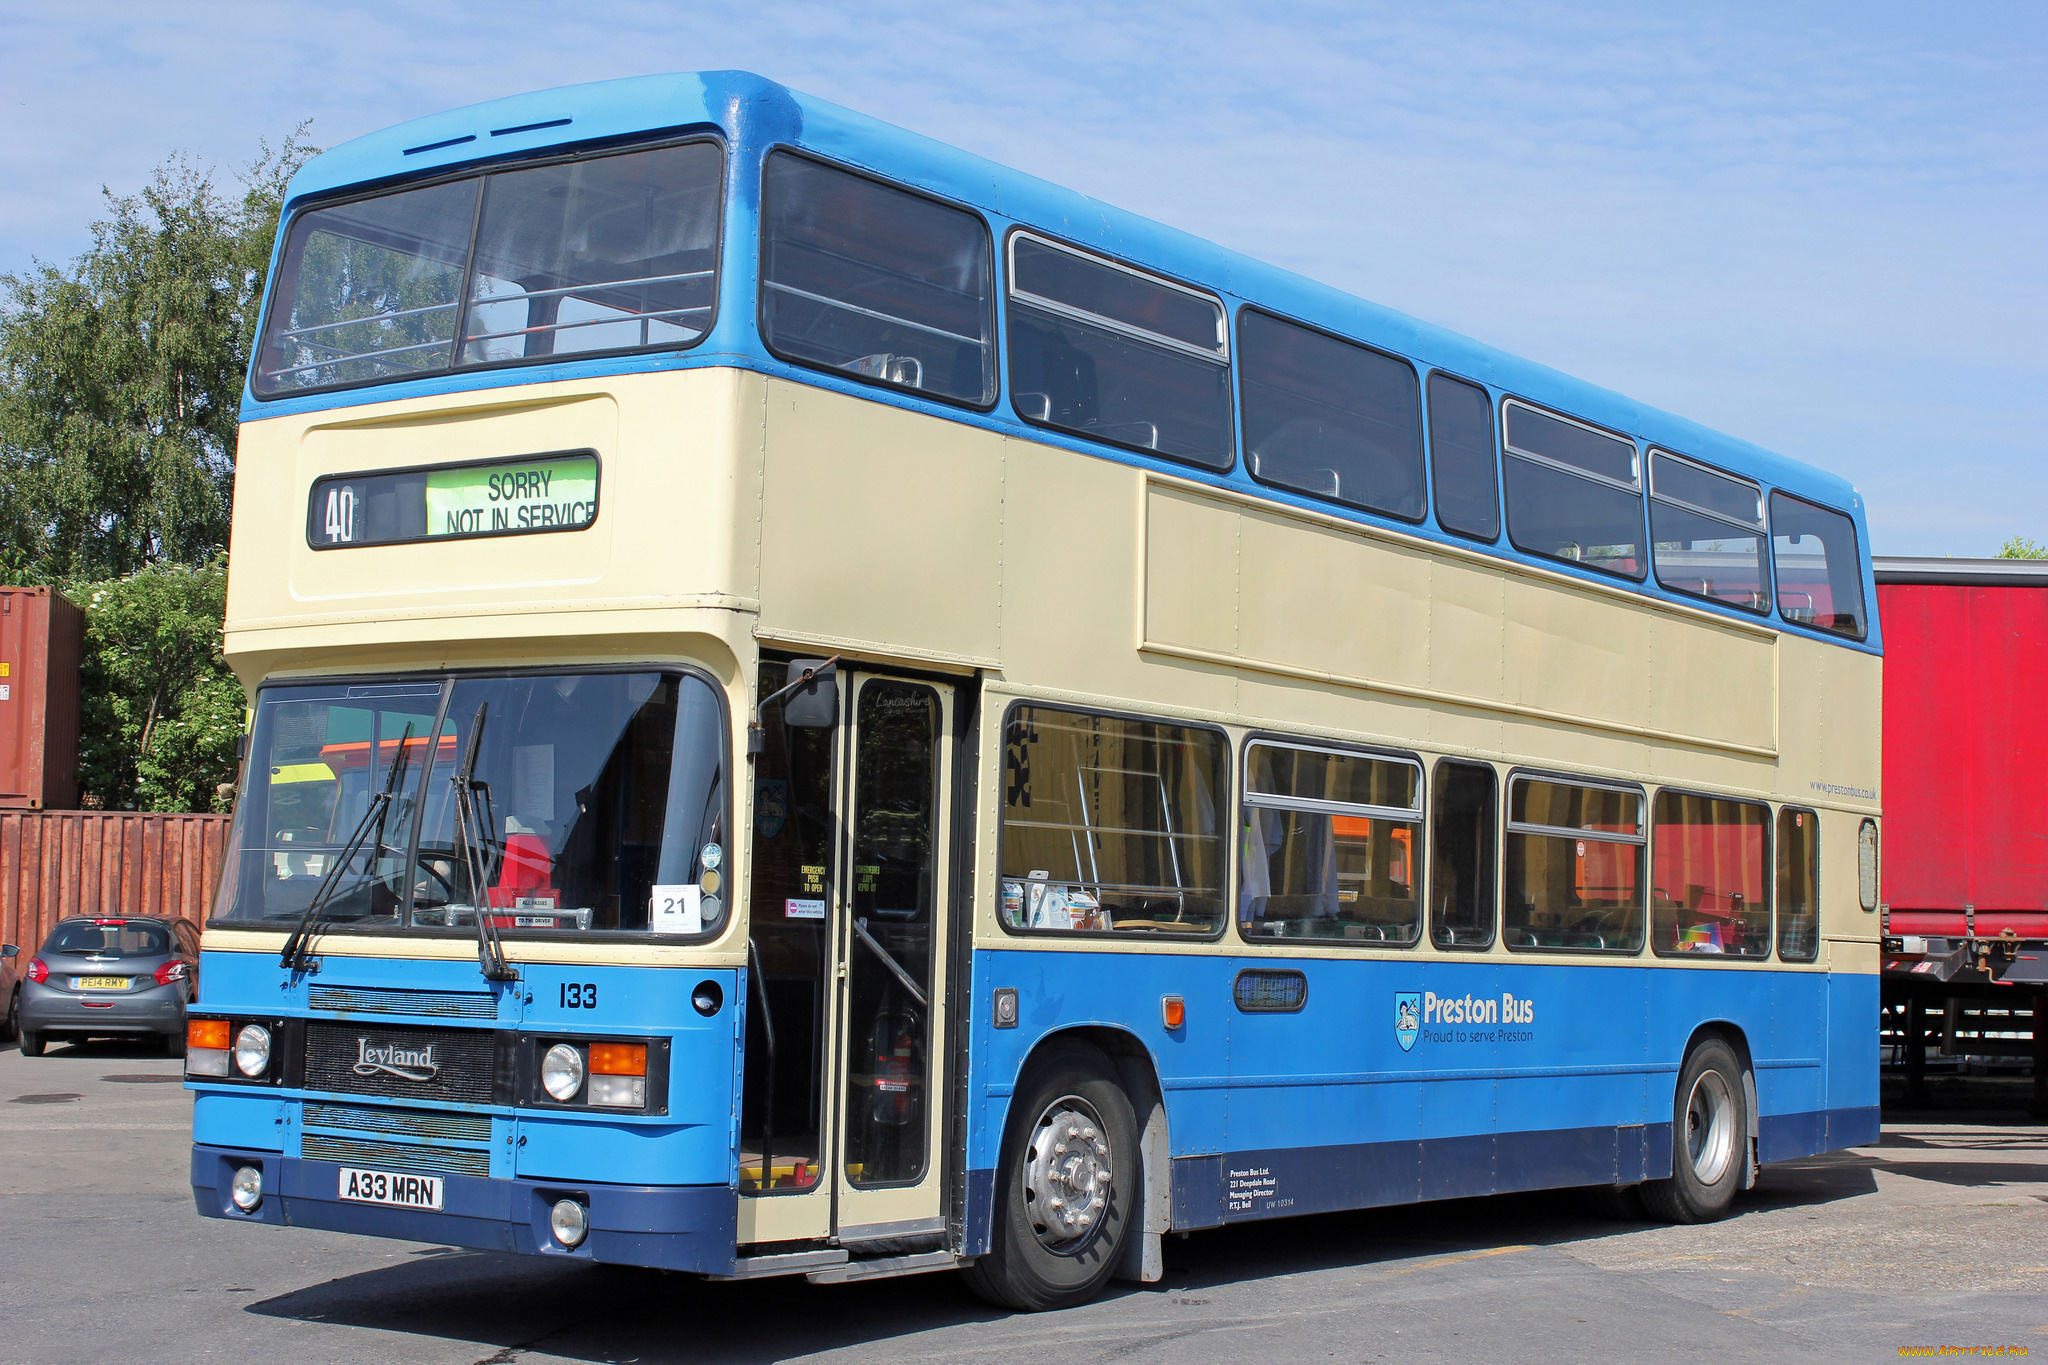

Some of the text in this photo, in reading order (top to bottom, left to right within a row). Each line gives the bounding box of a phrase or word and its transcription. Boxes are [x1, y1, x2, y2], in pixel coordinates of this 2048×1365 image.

[488, 470, 552, 502] SORRY
[325, 485, 354, 543] 40
[447, 508, 484, 534] NOT
[492, 507, 509, 532] IN
[876, 690, 930, 708] Lancashire
[1809, 780, 1877, 800] www.prestonbus.co.uk
[801, 865, 826, 875] EMERGENCY
[807, 875, 819, 883] PUSH
[804, 883, 823, 893] TO OPEN
[663, 897, 685, 914] 21
[81, 978, 124, 987] PE14 RMY
[560, 982, 597, 1009] 133
[1424, 991, 1534, 1024] Preston Bus
[1401, 1034, 1413, 1045] PP
[1423, 1029, 1534, 1043] Proud to serve Preston
[354, 1037, 438, 1076] Leyland
[1230, 1167, 1270, 1178] Preston Bus Ltd.
[347, 1171, 434, 1206] A33 MRN
[1230, 1177, 1276, 1188] 221 Deepdale Road
[1229, 1189, 1274, 1200] Managing Director
[1241, 1200, 1252, 1209] Bell
[1266, 1198, 1294, 1209] UW 10314
